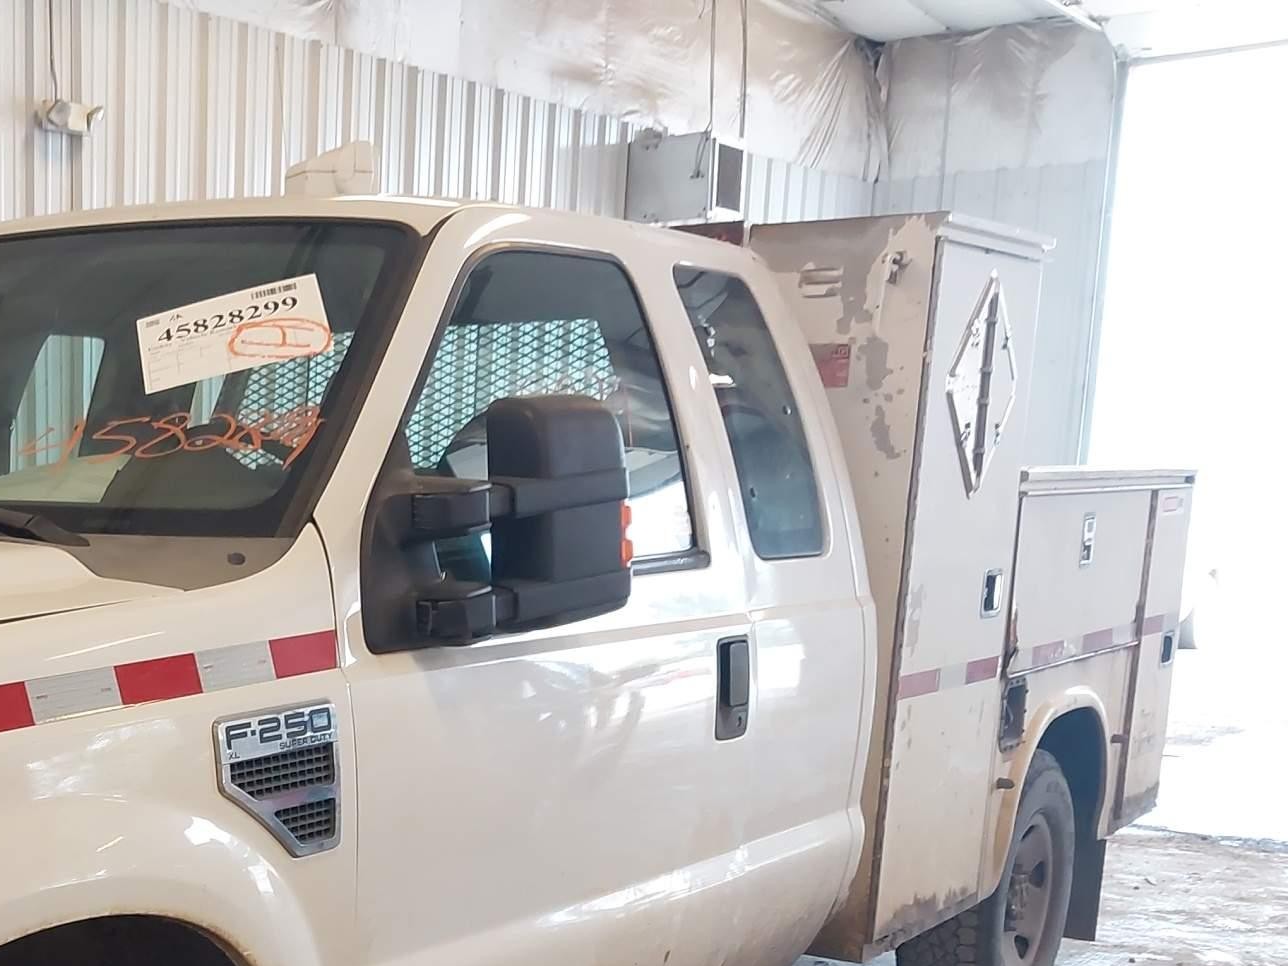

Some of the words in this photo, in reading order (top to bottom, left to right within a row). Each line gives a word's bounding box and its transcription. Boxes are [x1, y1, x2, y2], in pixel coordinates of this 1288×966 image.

[158, 296, 298, 342] 45828299
[225, 707, 332, 750] F-250
[279, 738, 309, 750] SUPER
[311, 732, 334, 743] DUTY
[228, 752, 241, 760] XL
